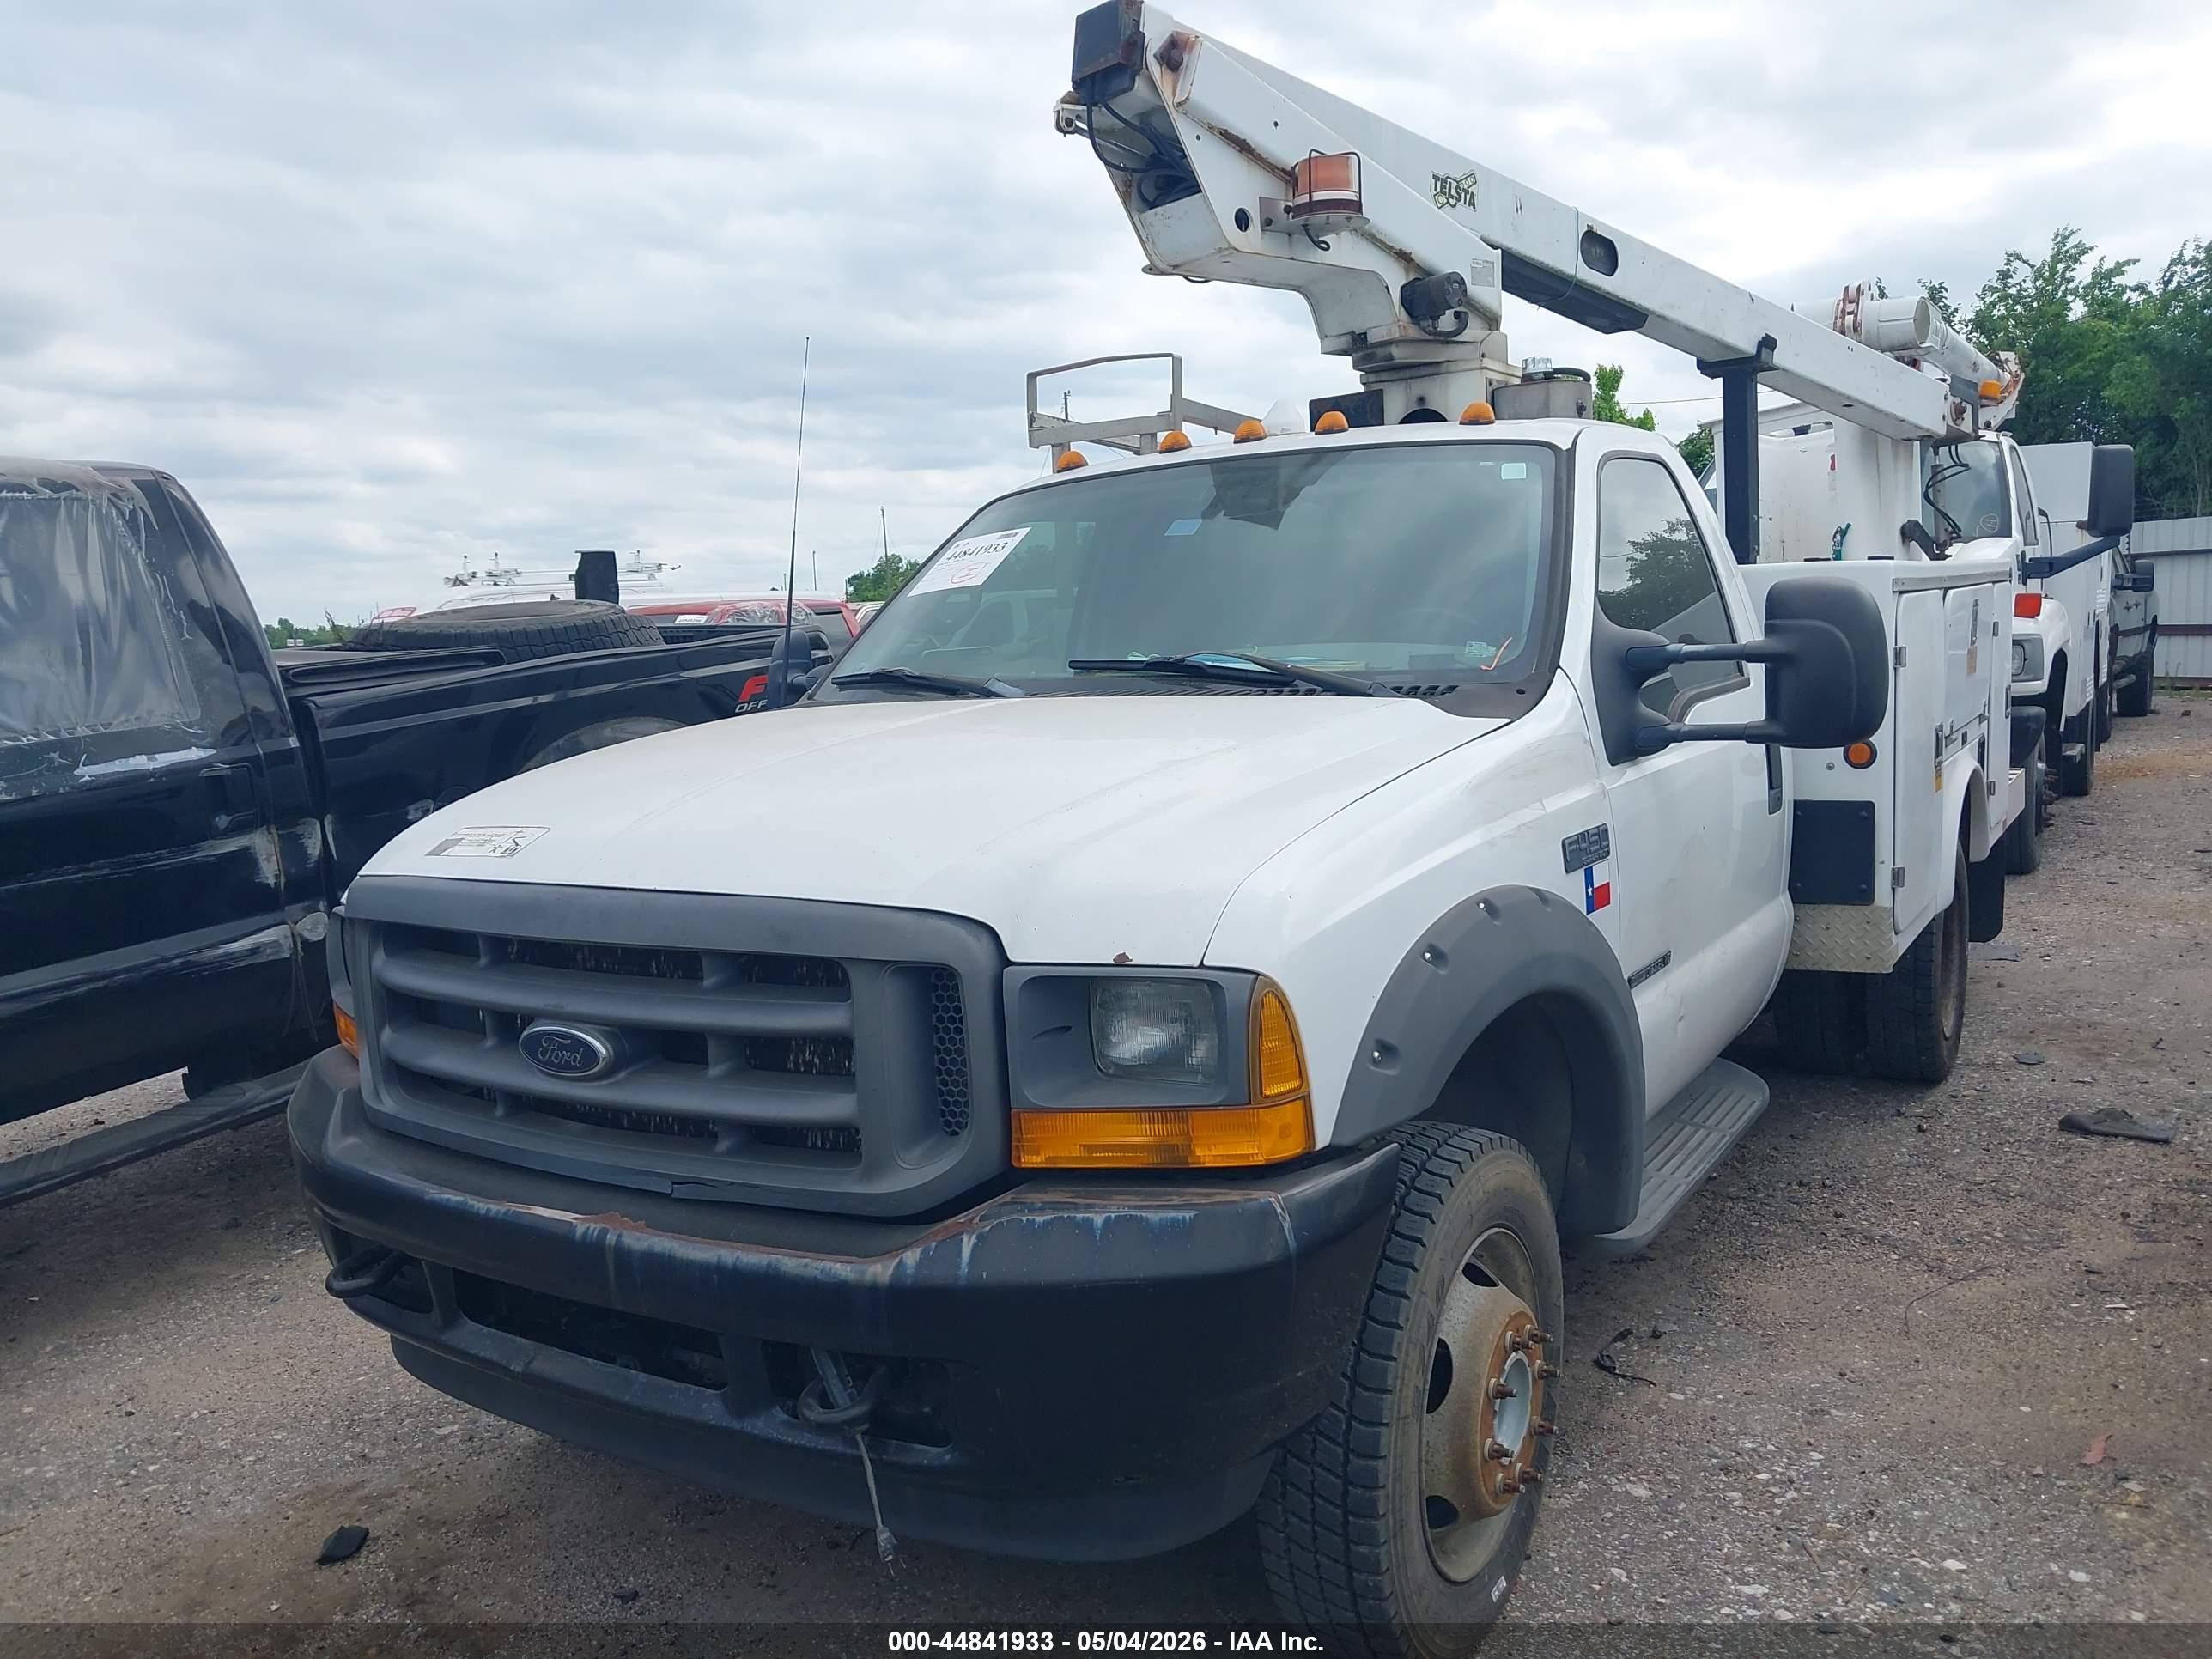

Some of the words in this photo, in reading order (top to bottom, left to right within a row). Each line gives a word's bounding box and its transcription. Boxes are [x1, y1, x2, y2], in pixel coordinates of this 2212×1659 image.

[1431, 173, 1476, 210] TELSTA
[735, 700, 769, 713] OFF
[538, 1035, 584, 1066] Ford
